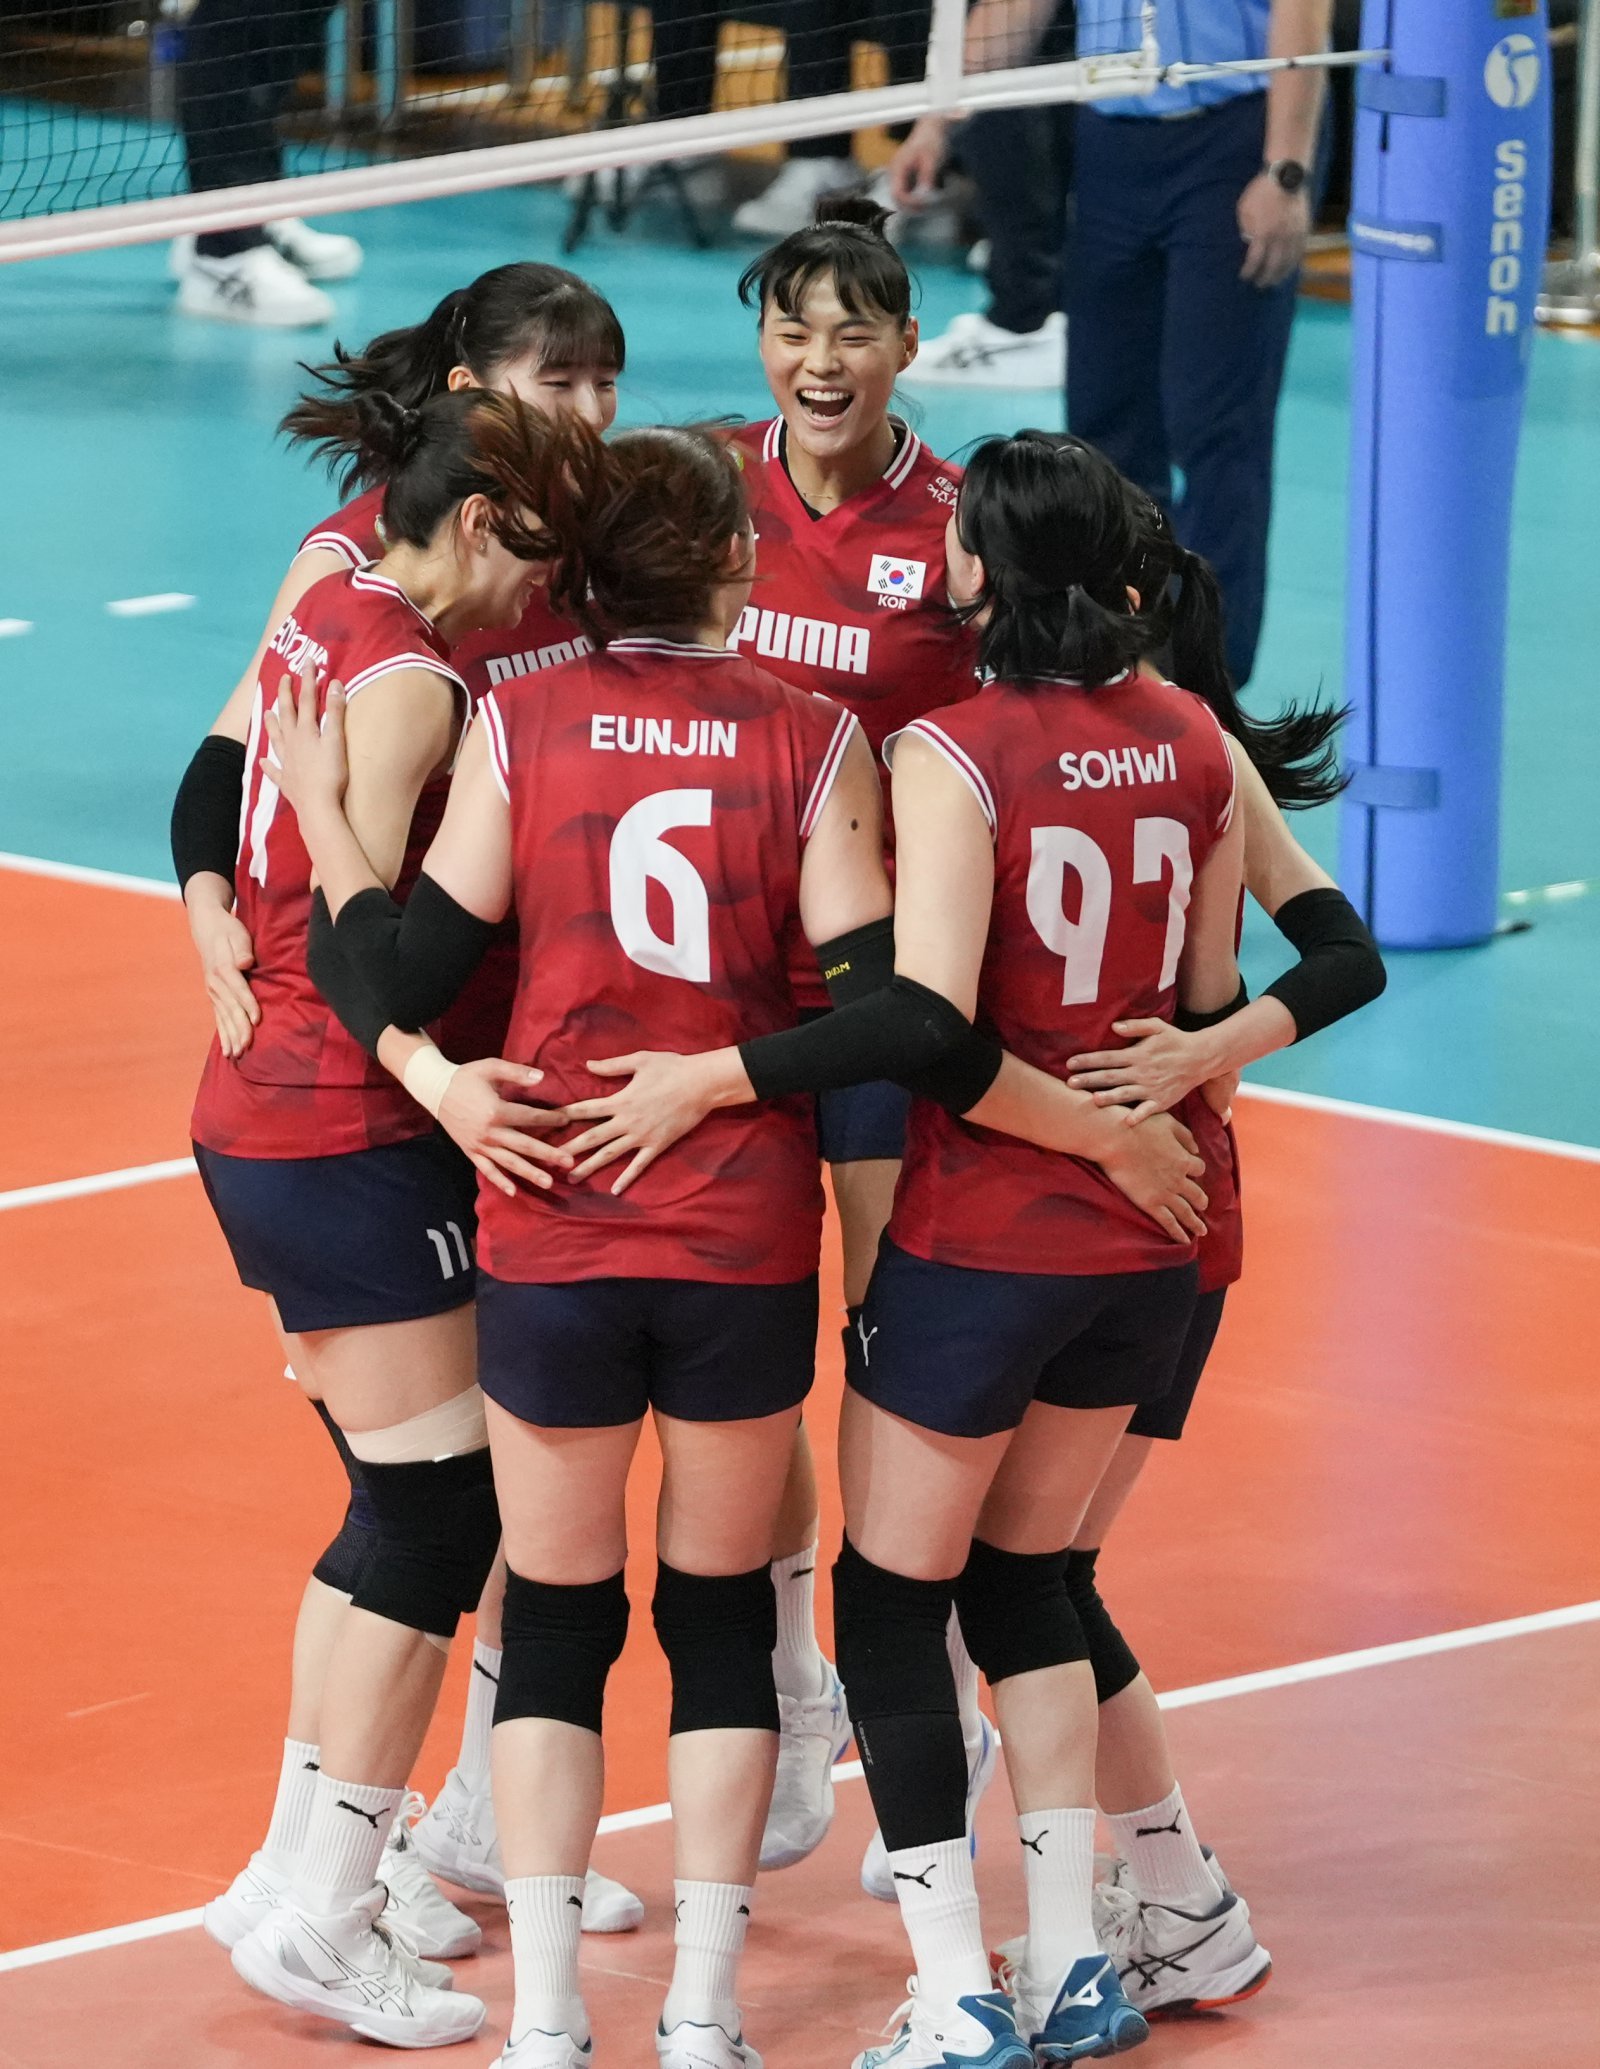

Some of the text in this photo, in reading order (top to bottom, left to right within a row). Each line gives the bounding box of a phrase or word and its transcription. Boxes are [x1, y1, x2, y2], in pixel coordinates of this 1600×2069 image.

[878, 594, 908, 611] KOR
[725, 605, 871, 675] PUMA
[590, 714, 738, 758] EUNJIN
[1058, 743, 1177, 791] SOHWI
[609, 788, 712, 983] 6
[1025, 816, 1194, 1006] 97
[425, 1220, 470, 1280] 11
